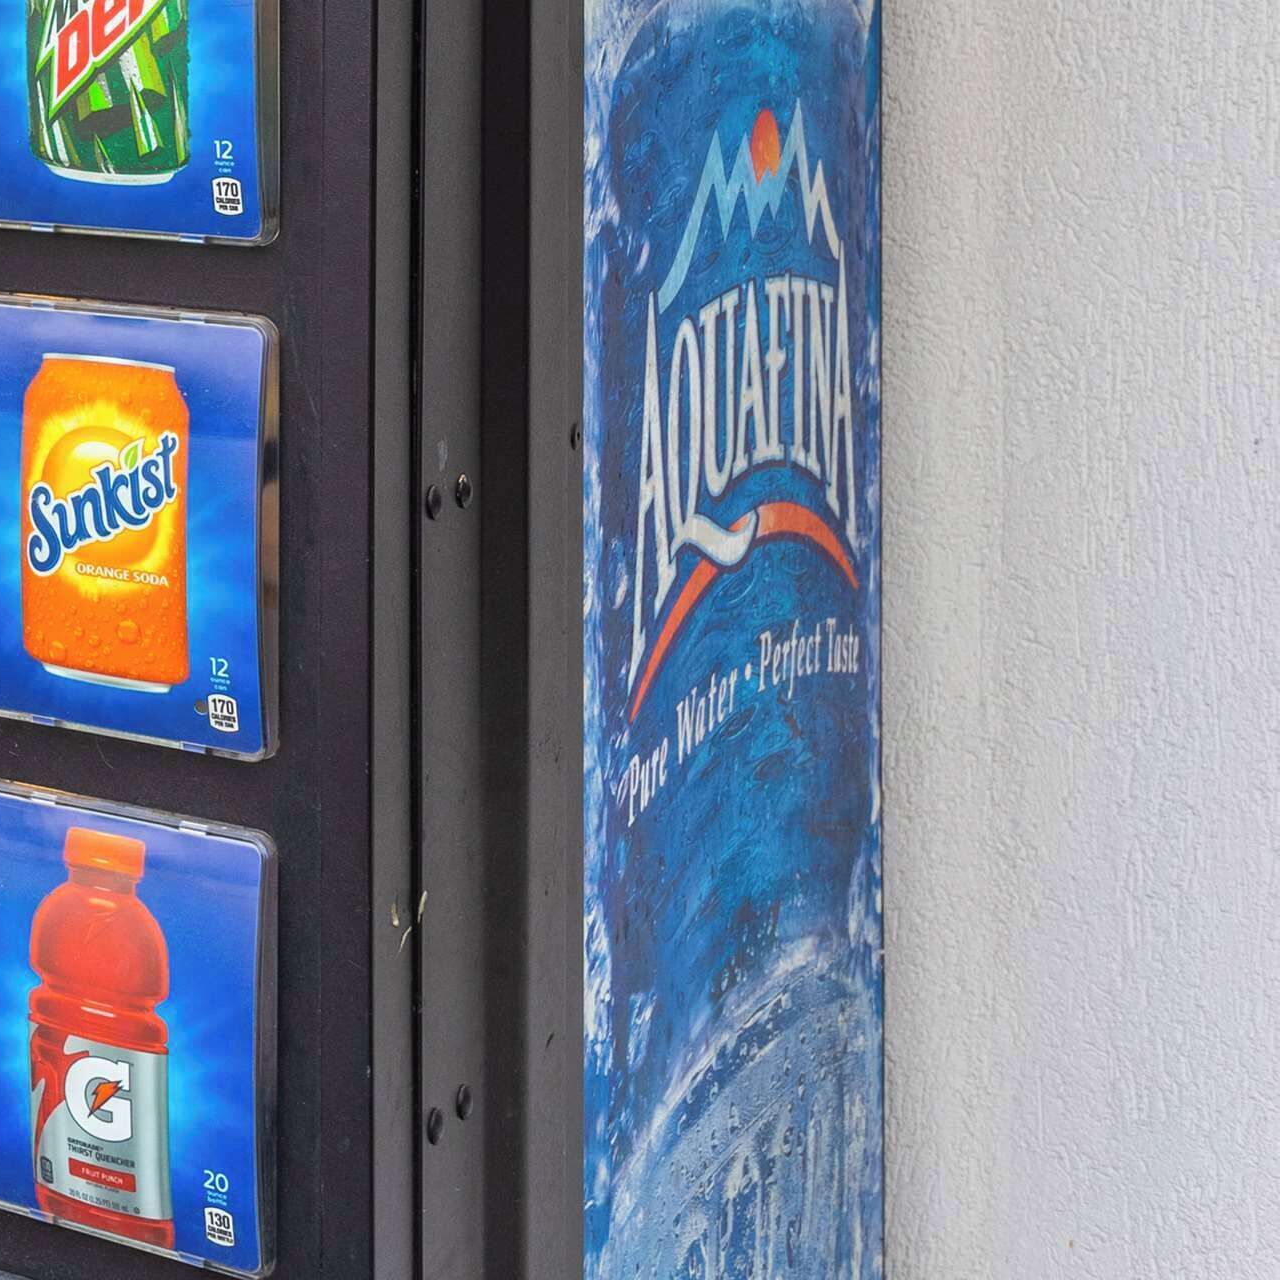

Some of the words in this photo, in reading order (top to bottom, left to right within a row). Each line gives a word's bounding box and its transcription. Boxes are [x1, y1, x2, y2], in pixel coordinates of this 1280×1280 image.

[213, 140, 234, 160] 12
[215, 181, 239, 197] 170
[627, 240, 859, 696] AQUAFINA
[29, 434, 178, 573] Sunkist
[76, 562, 131, 581] ORANGE
[132, 571, 169, 587] SODA
[209, 657, 229, 678] 12
[211, 698, 234, 715] 170
[628, 737, 669, 828] Pure
[676, 667, 738, 765] Water
[758, 619, 821, 699] Perfect
[826, 618, 860, 674] Taste
[65, 1055, 133, 1143] G
[67, 1143, 93, 1158] THIRST
[95, 1151, 135, 1168] QUENCHER
[81, 1167, 100, 1179] FRUIT
[101, 1172, 124, 1185] PUNCH
[203, 1169, 229, 1193] 20
[208, 1211, 231, 1230] 130
